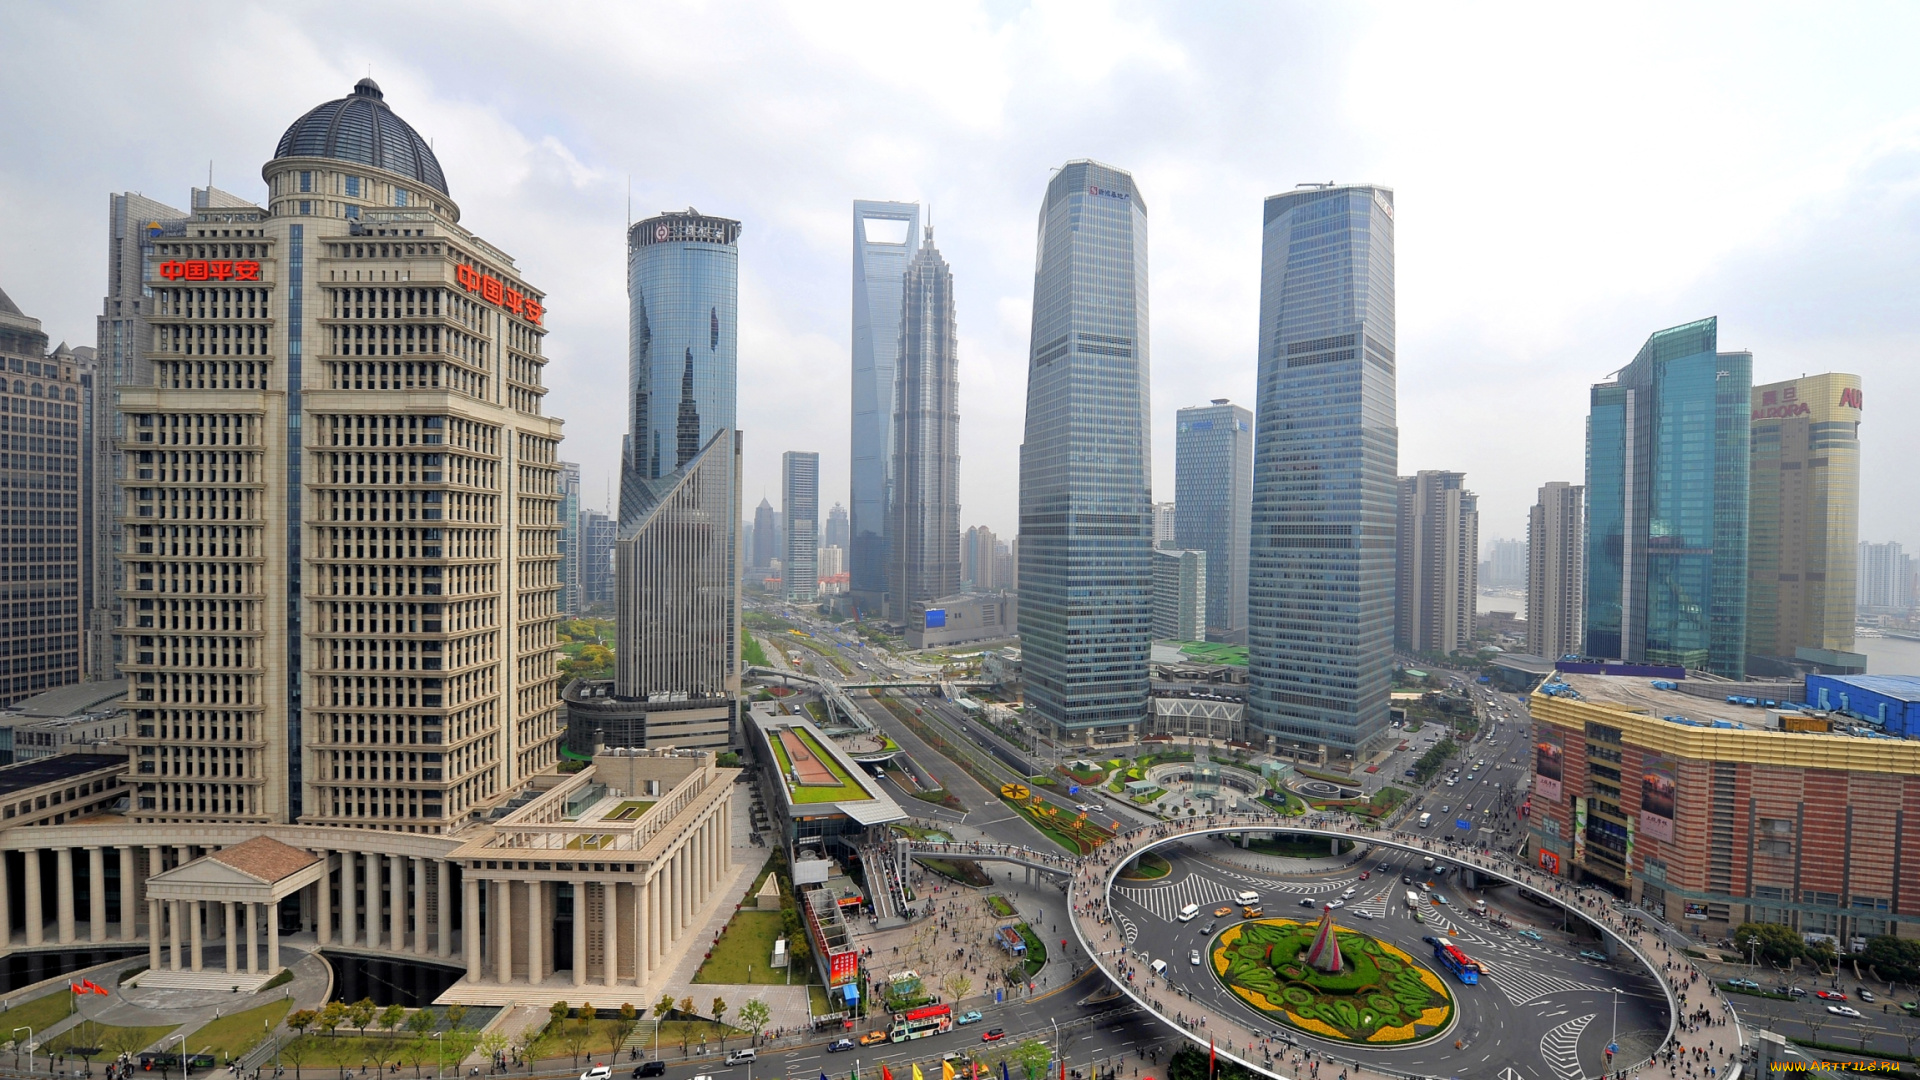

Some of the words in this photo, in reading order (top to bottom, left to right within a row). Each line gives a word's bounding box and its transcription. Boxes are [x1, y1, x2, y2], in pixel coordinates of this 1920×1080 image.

[160, 259, 259, 281] 中国平安
[457, 263, 543, 326] 中国平安
[1751, 402, 1811, 420] AURORA
